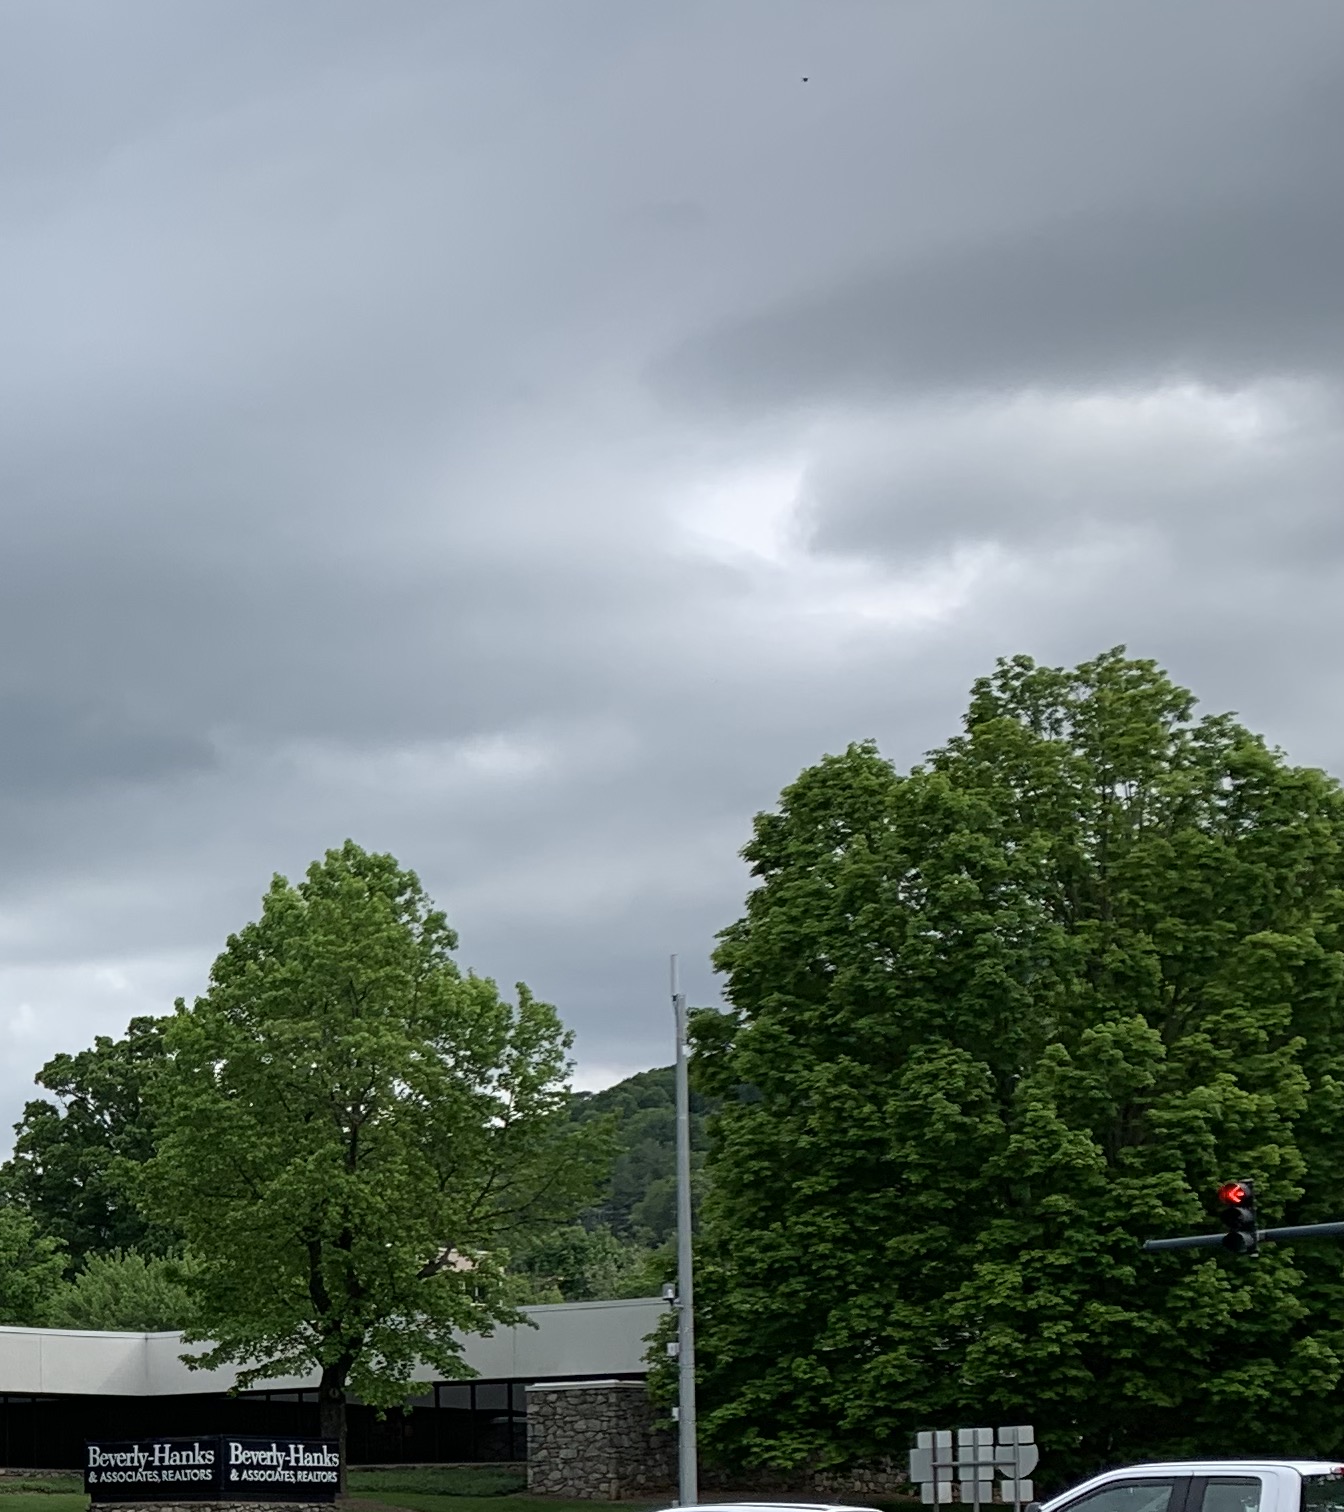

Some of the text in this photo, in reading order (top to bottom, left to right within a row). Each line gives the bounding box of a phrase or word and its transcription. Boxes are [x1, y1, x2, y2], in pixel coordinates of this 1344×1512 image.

[88, 1442, 215, 1472] Beverly-Hanks
[229, 1442, 340, 1471] Beverly-Hanks
[88, 1469, 213, 1484] & ASSOCIATES, REALTORS
[230, 1468, 338, 1484] & ASSOCIATES, REALTORS
